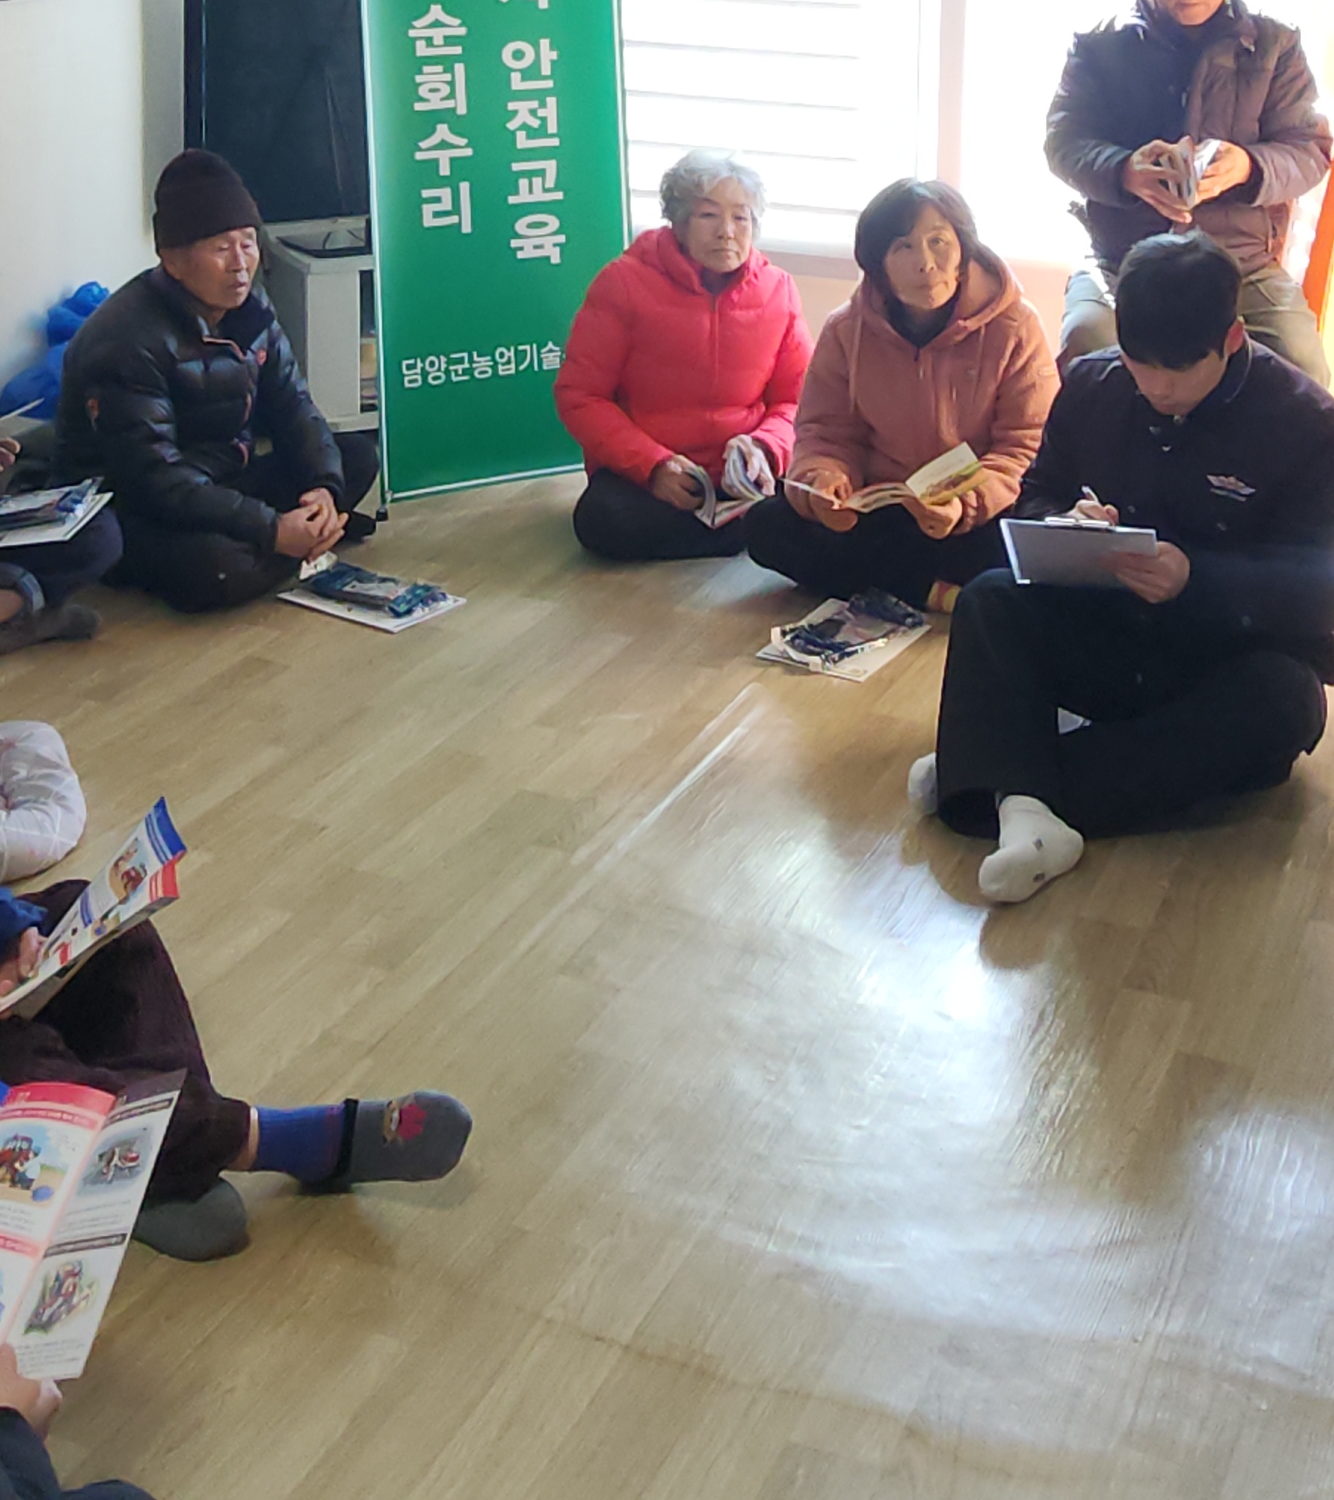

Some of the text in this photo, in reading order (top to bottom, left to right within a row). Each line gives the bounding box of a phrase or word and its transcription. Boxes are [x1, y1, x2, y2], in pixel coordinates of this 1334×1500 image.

[407, 3, 473, 234] 순회수리
[500, 38, 566, 264] 안전교육
[401, 340, 566, 389] 담양군농업기술
